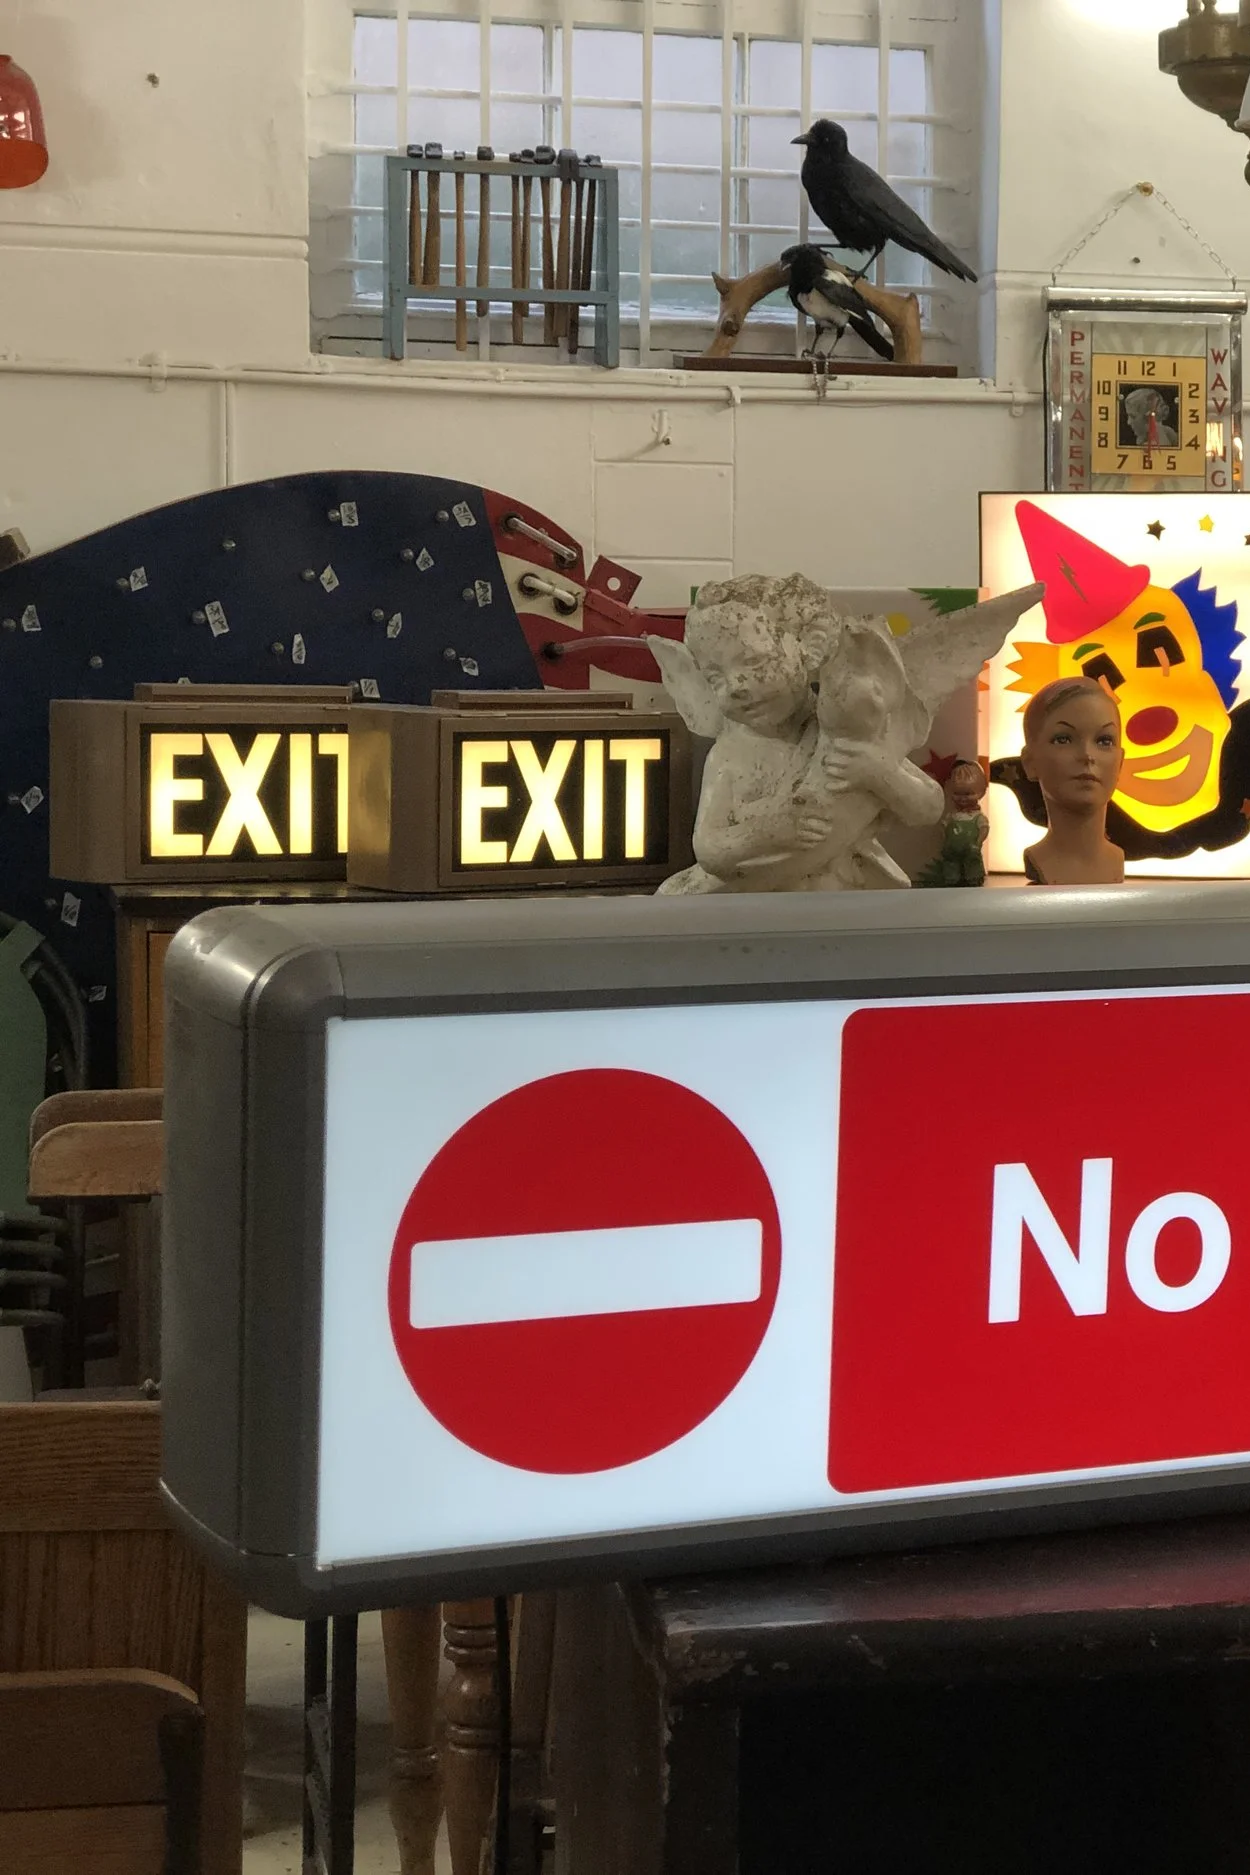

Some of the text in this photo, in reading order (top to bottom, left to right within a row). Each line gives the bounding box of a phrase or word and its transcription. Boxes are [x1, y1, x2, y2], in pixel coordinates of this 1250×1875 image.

[1117, 360, 1177, 377] 11 12 1
[1096, 380, 1111, 396] 10
[1188, 383, 1200, 399] 2
[1068, 330, 1086, 491] PERMANENT
[1098, 406, 1109, 421] 9
[1188, 409, 1199, 424] 3
[1210, 348, 1229, 488] WAVNG
[1097, 432, 1108, 448] 8
[1185, 434, 1200, 450] 4
[1116, 454, 1176, 471] 7 6 5
[460, 738, 662, 865] EXIT
[987, 1156, 1232, 1325] No
